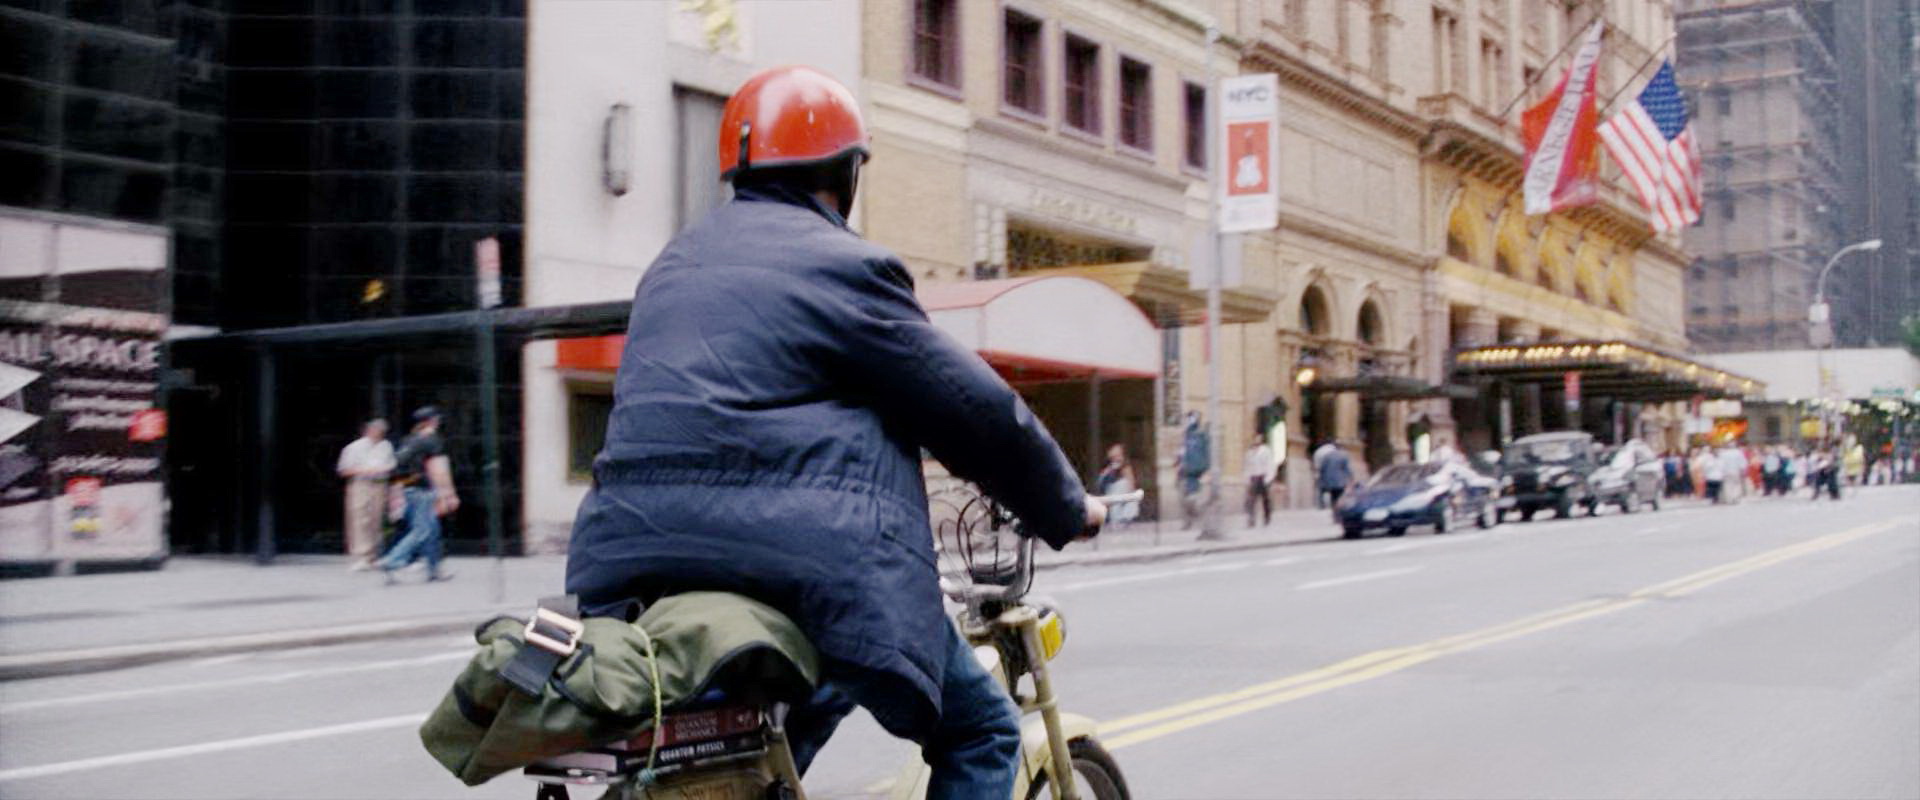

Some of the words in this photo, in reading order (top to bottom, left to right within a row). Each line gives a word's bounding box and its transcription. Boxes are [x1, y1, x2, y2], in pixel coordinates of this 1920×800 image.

[1228, 86, 1270, 103] NYC
[52, 333, 160, 371] SPACE
[660, 746, 695, 761] QUANTUM
[696, 740, 725, 753] PHYSICS
